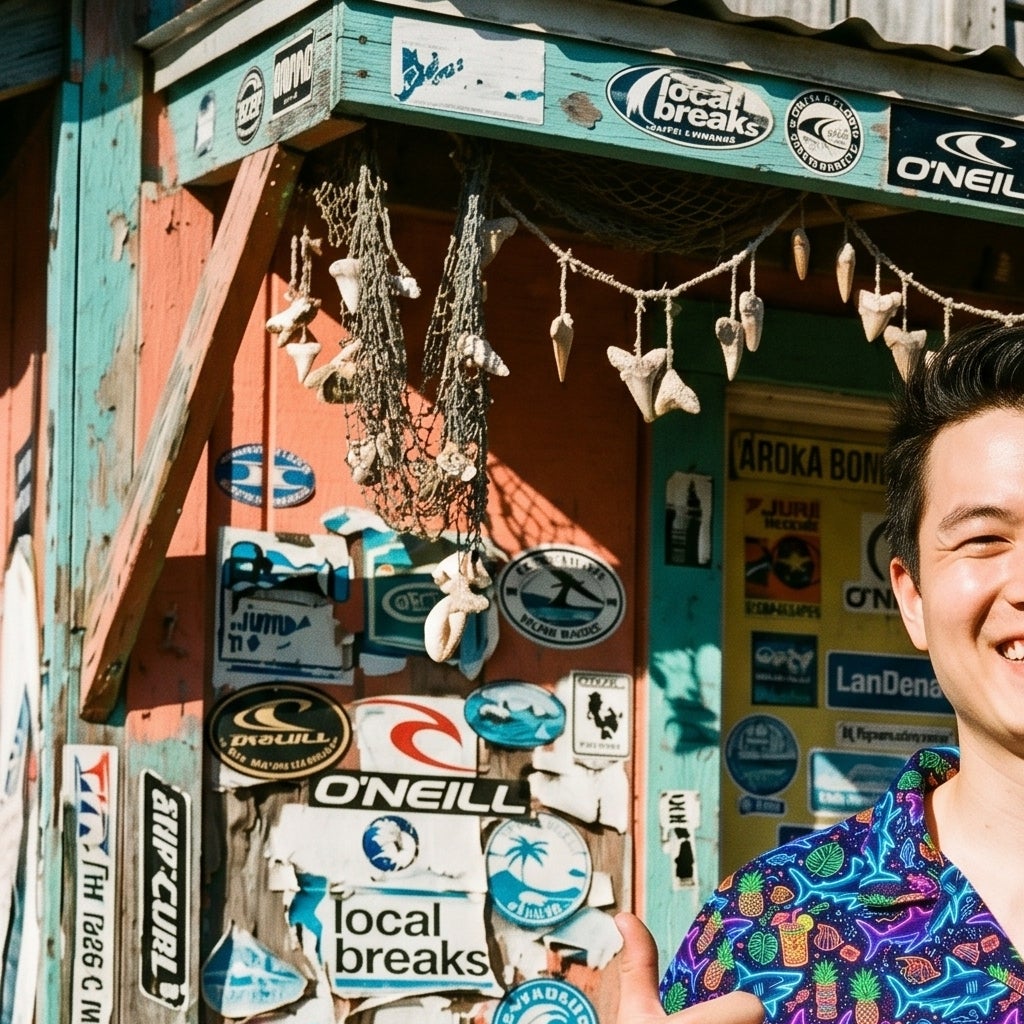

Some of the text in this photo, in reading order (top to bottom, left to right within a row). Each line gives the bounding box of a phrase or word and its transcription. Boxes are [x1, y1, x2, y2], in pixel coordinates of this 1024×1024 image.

[656, 76, 738, 111] local
[653, 96, 760, 138] breaks
[739, 437, 823, 479] AROKA
[314, 774, 527, 815] O'NEILL
[335, 900, 441, 936] local
[335, 938, 490, 976] breaks
